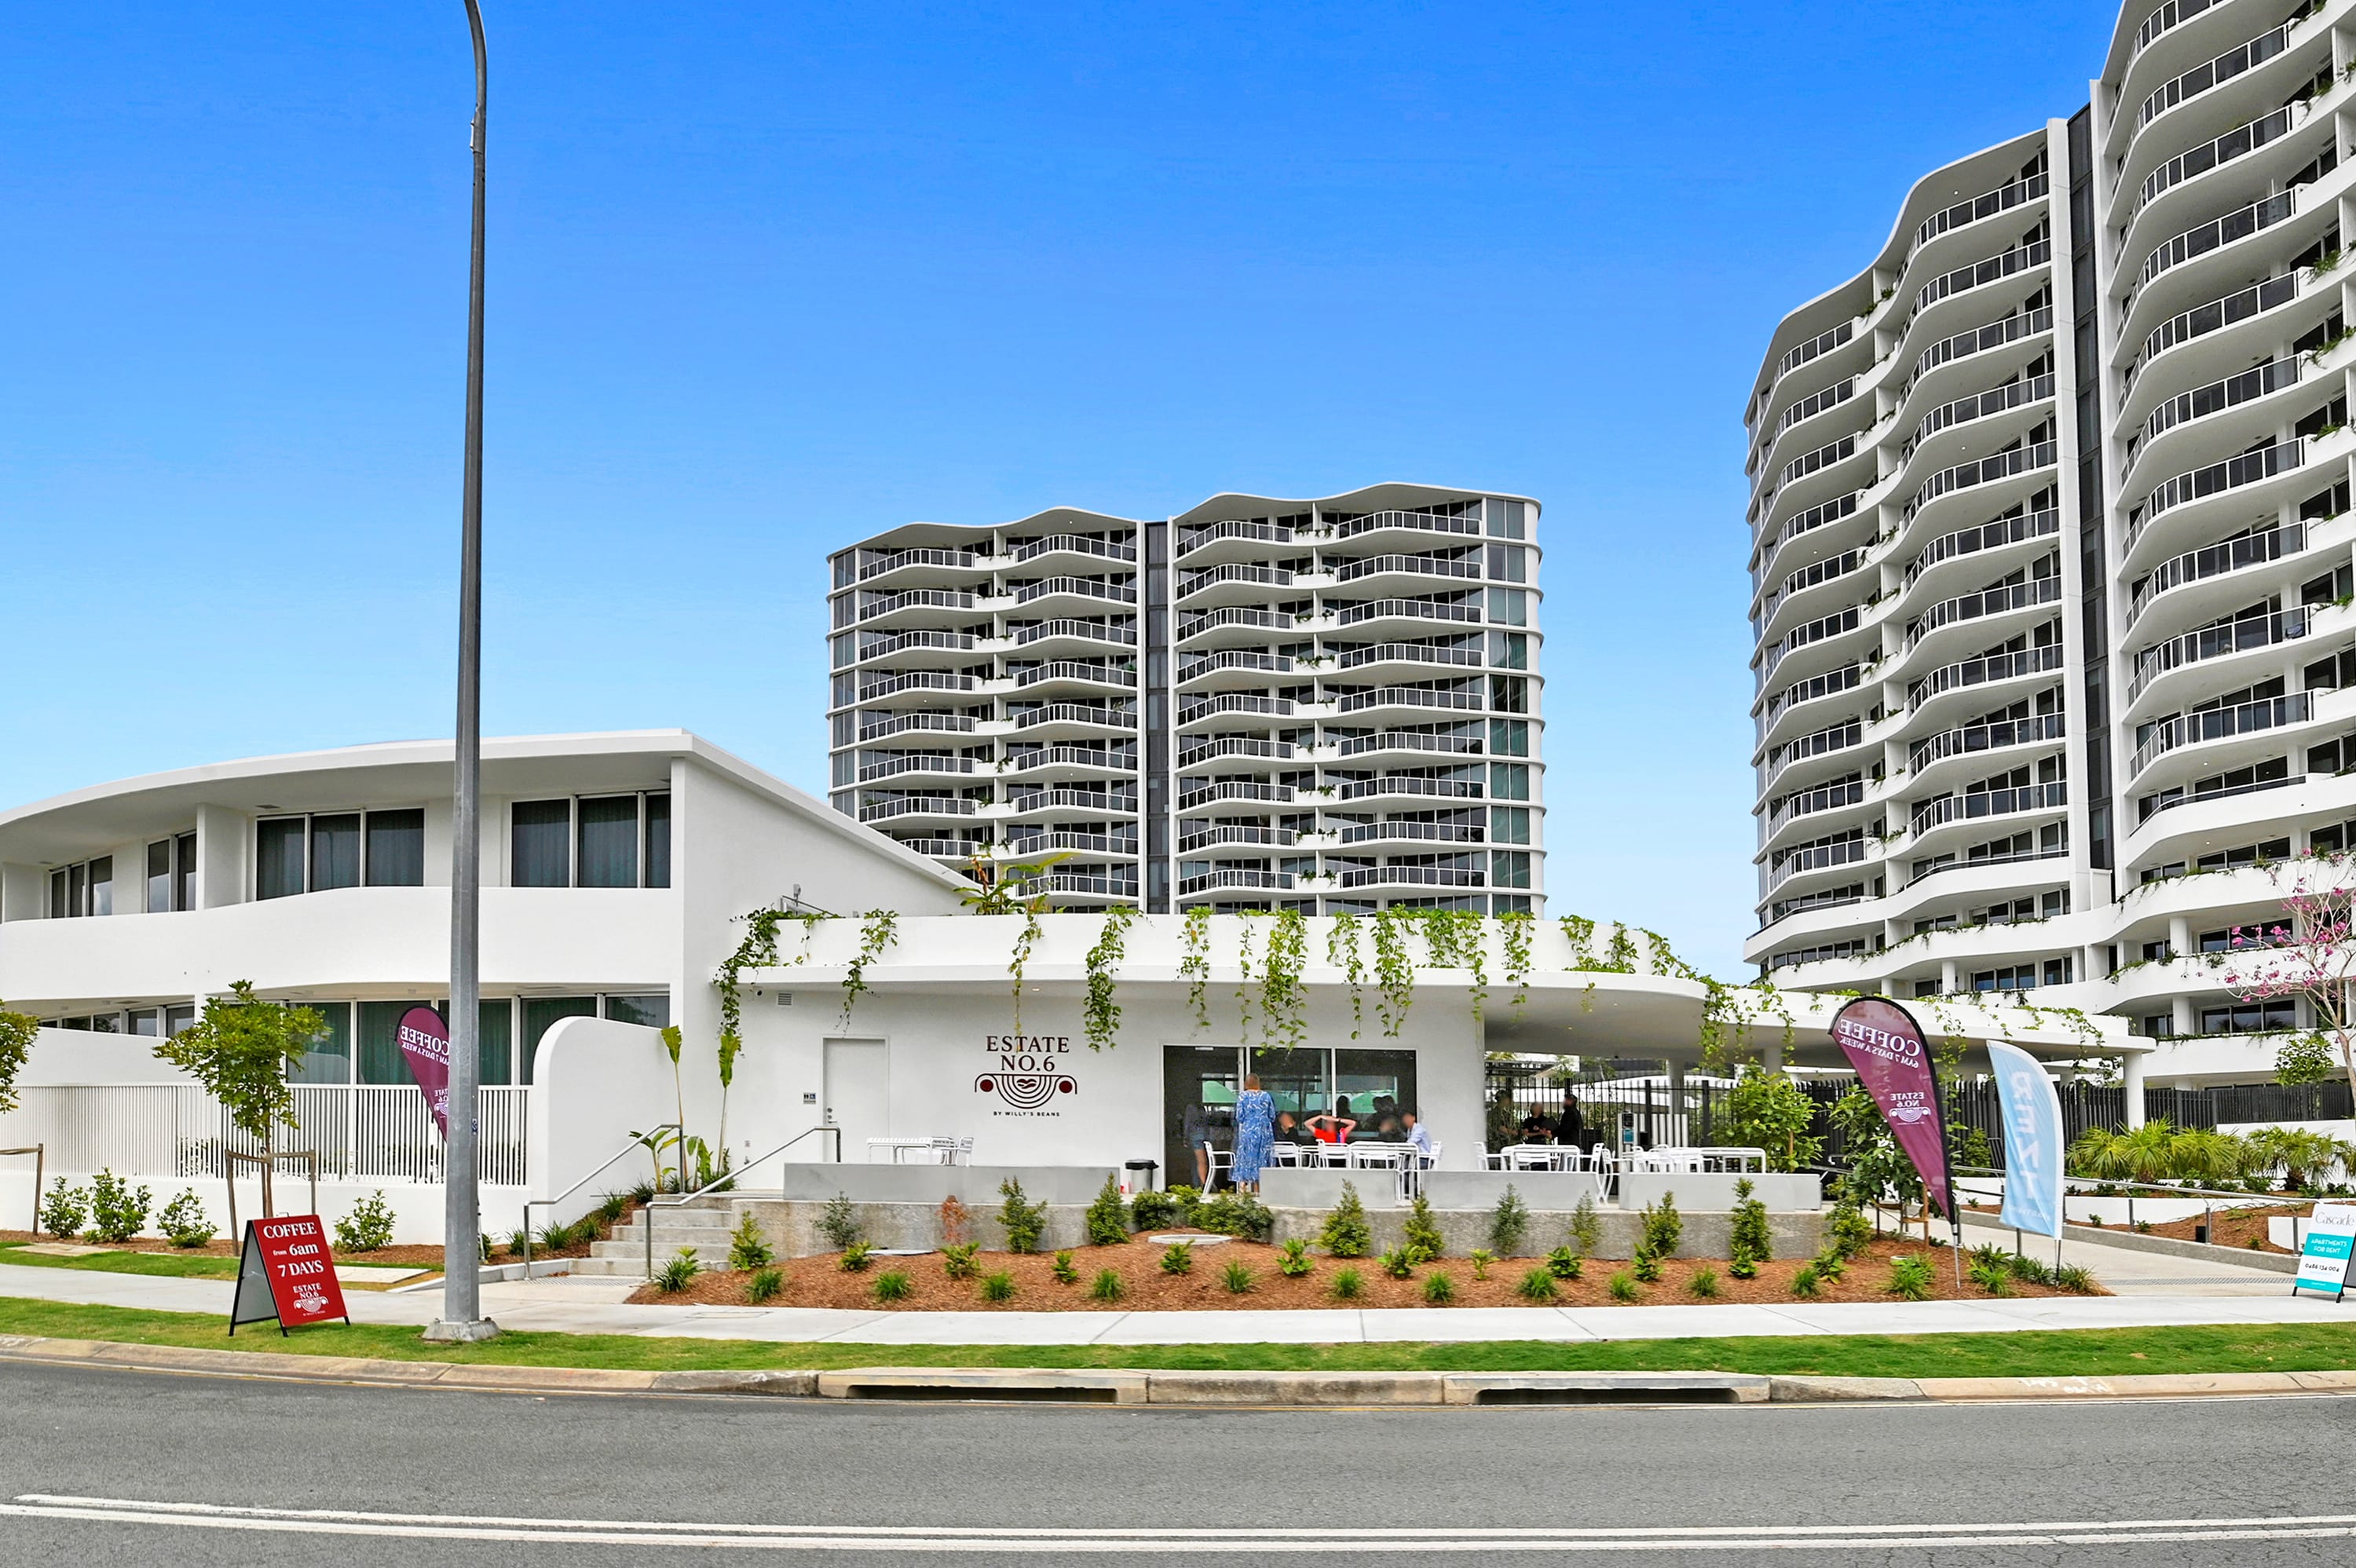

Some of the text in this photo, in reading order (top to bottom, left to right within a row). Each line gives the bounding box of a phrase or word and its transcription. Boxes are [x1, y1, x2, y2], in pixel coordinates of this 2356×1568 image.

[986, 1036, 1070, 1053] ESTATE
[1001, 1055, 1055, 1072] NO.6
[2315, 1212, 2354, 1226] Cascade
[263, 1222, 317, 1238] COFFEE
[2310, 1237, 2347, 1247] APARTMENTS
[289, 1243, 319, 1256] 6am
[277, 1259, 324, 1277] 7 DAYS
[293, 1282, 322, 1293] ESTATE
[299, 1291, 320, 1299] NO.6
